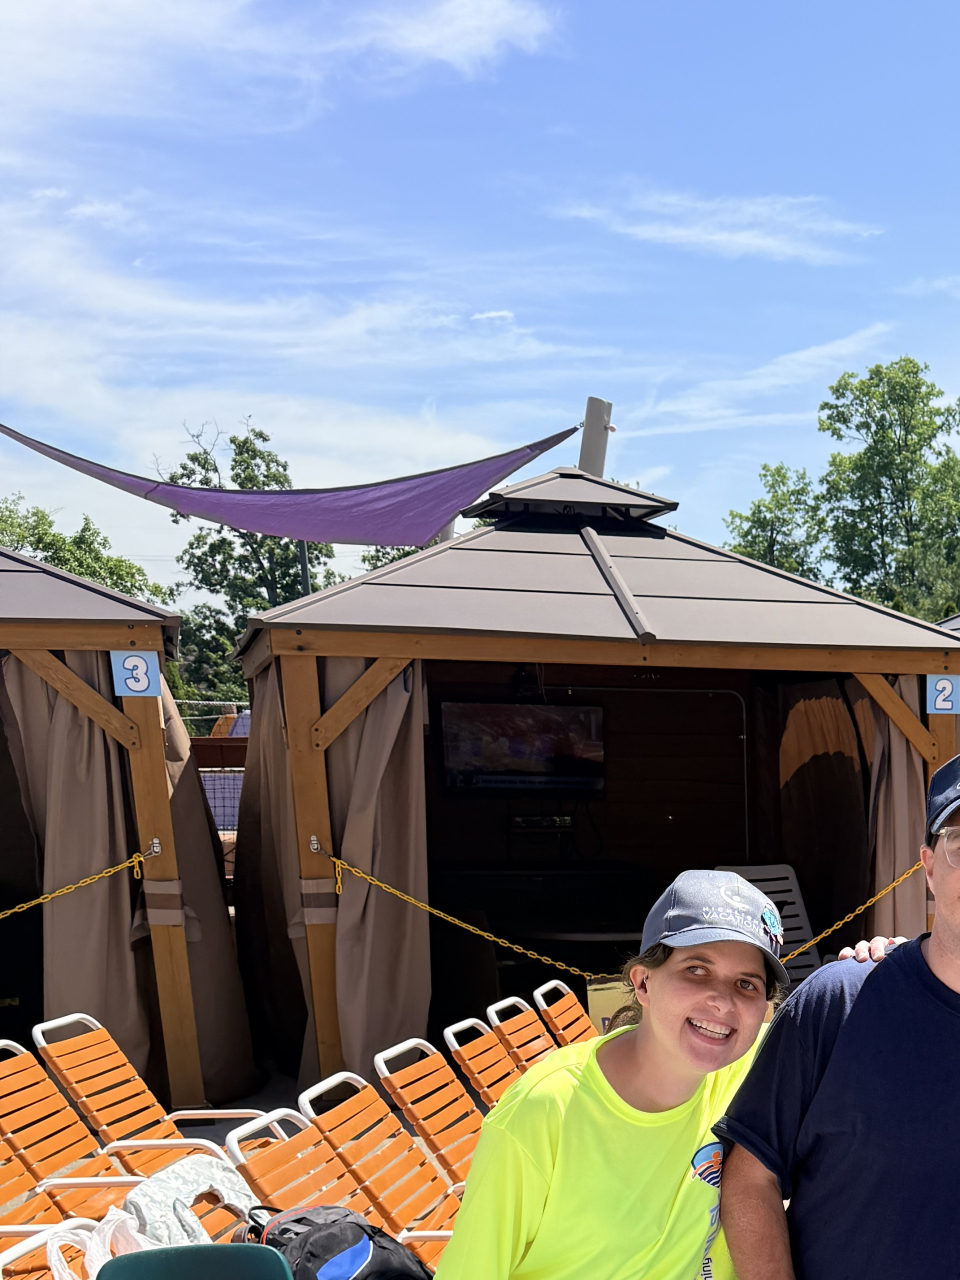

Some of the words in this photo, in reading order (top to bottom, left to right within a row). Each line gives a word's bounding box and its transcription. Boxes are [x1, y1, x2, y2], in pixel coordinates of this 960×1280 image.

[123, 655, 150, 692] 3
[934, 678, 954, 710] 2
[702, 911, 765, 937] VACATIONS
